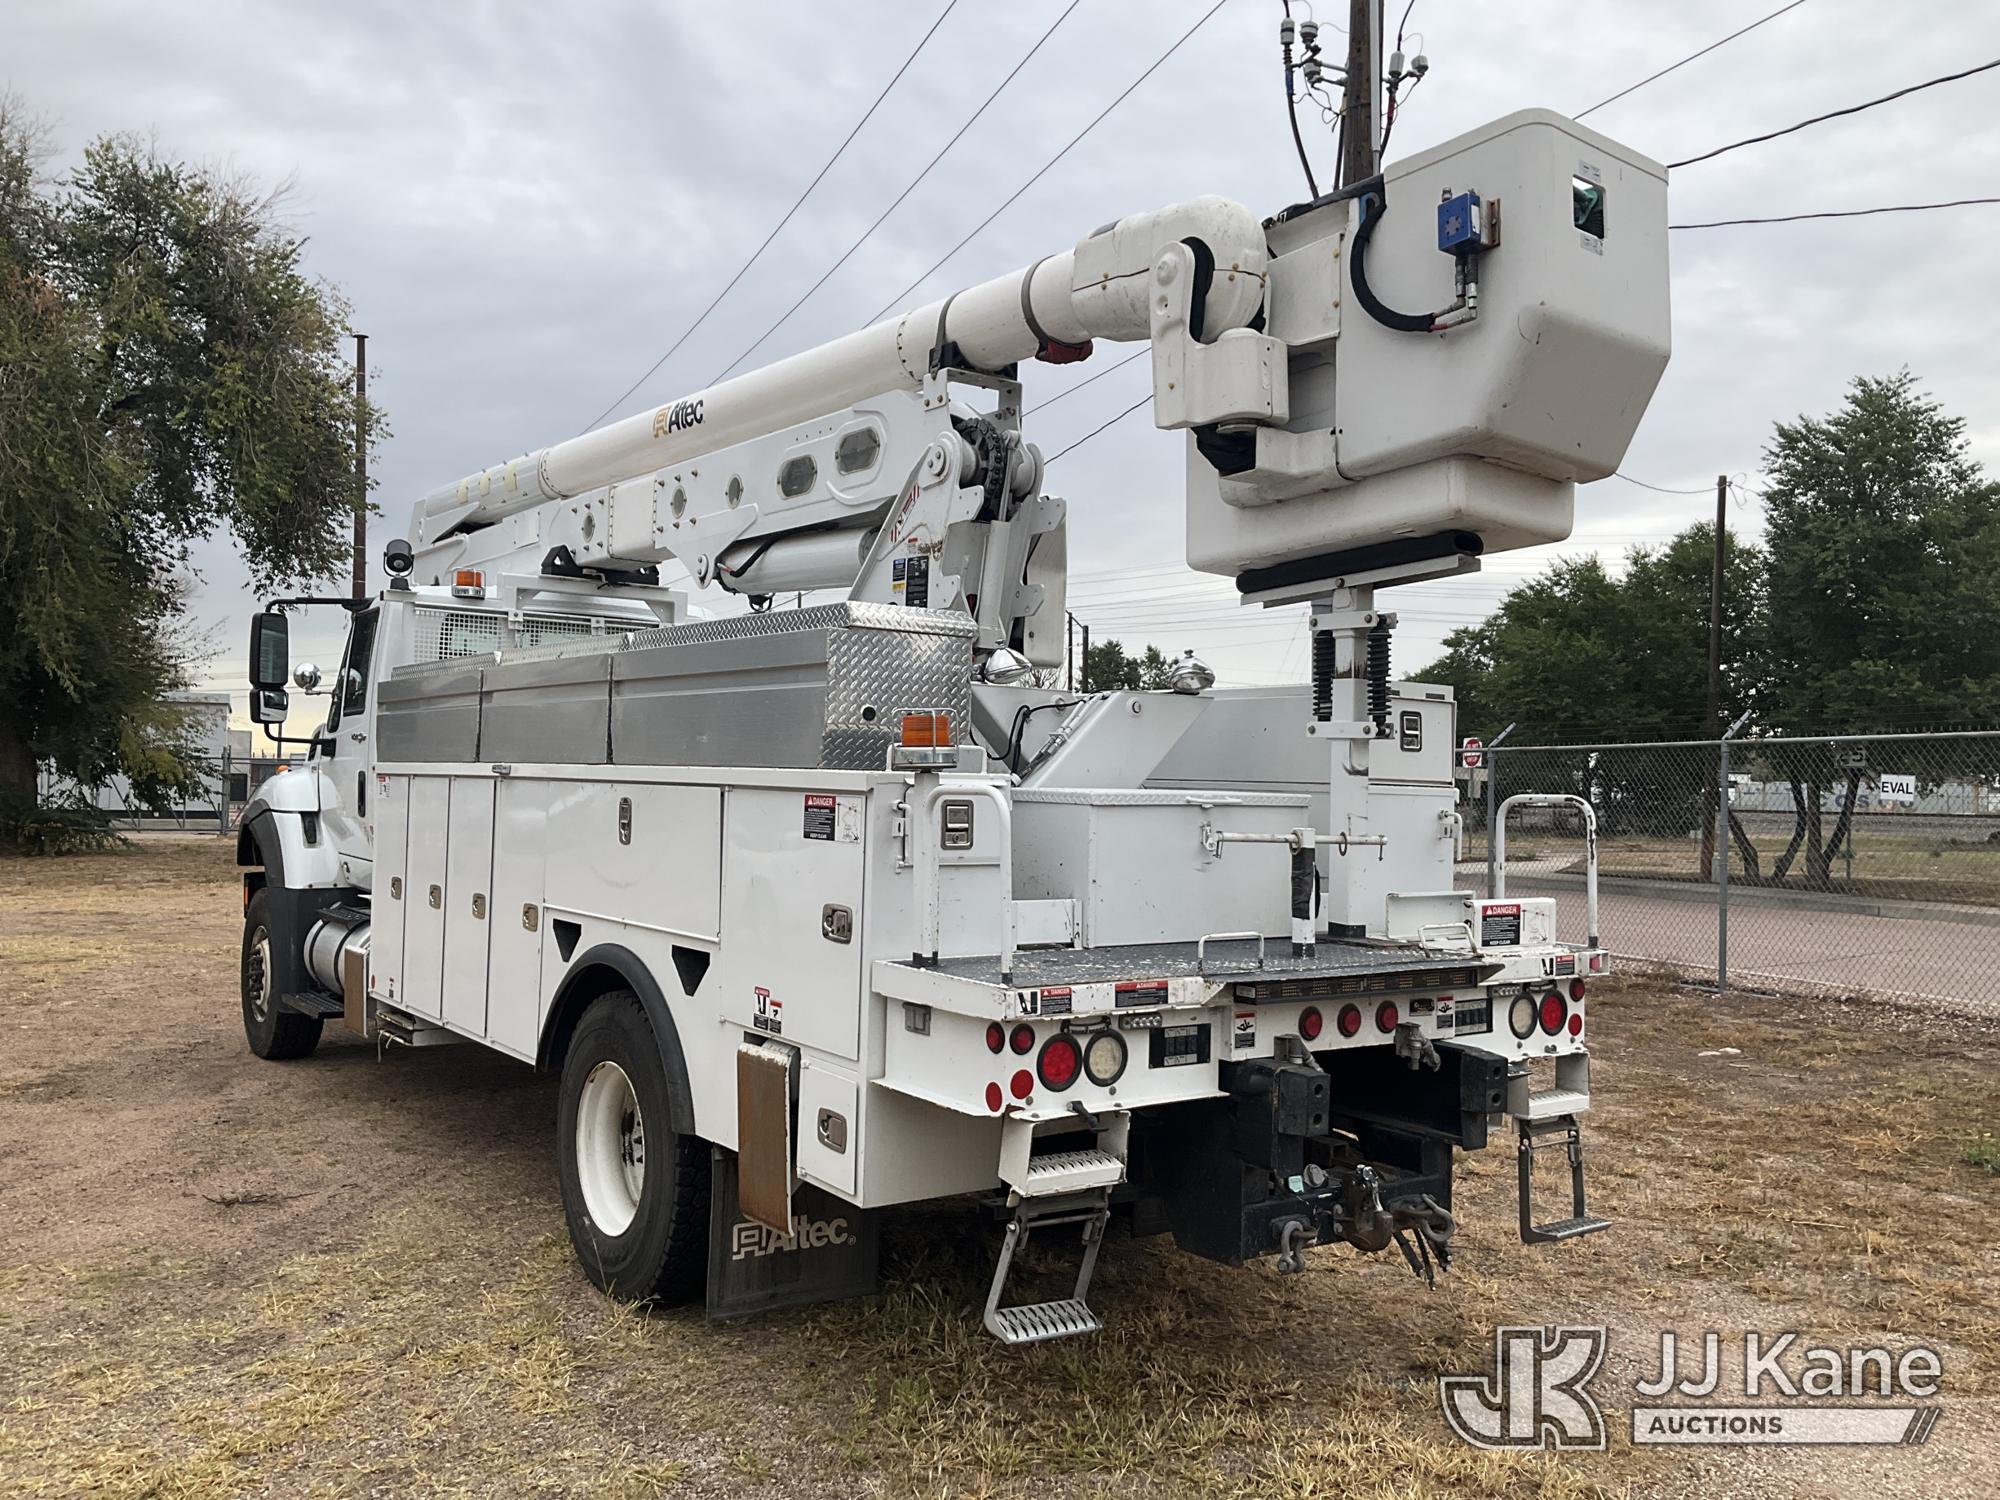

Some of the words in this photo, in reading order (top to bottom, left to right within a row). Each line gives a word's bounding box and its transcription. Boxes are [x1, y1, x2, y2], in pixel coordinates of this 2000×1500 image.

[668, 400, 703, 433] Altec
[1881, 781, 1913, 794] EVAL
[1492, 906, 1517, 914] DANGER
